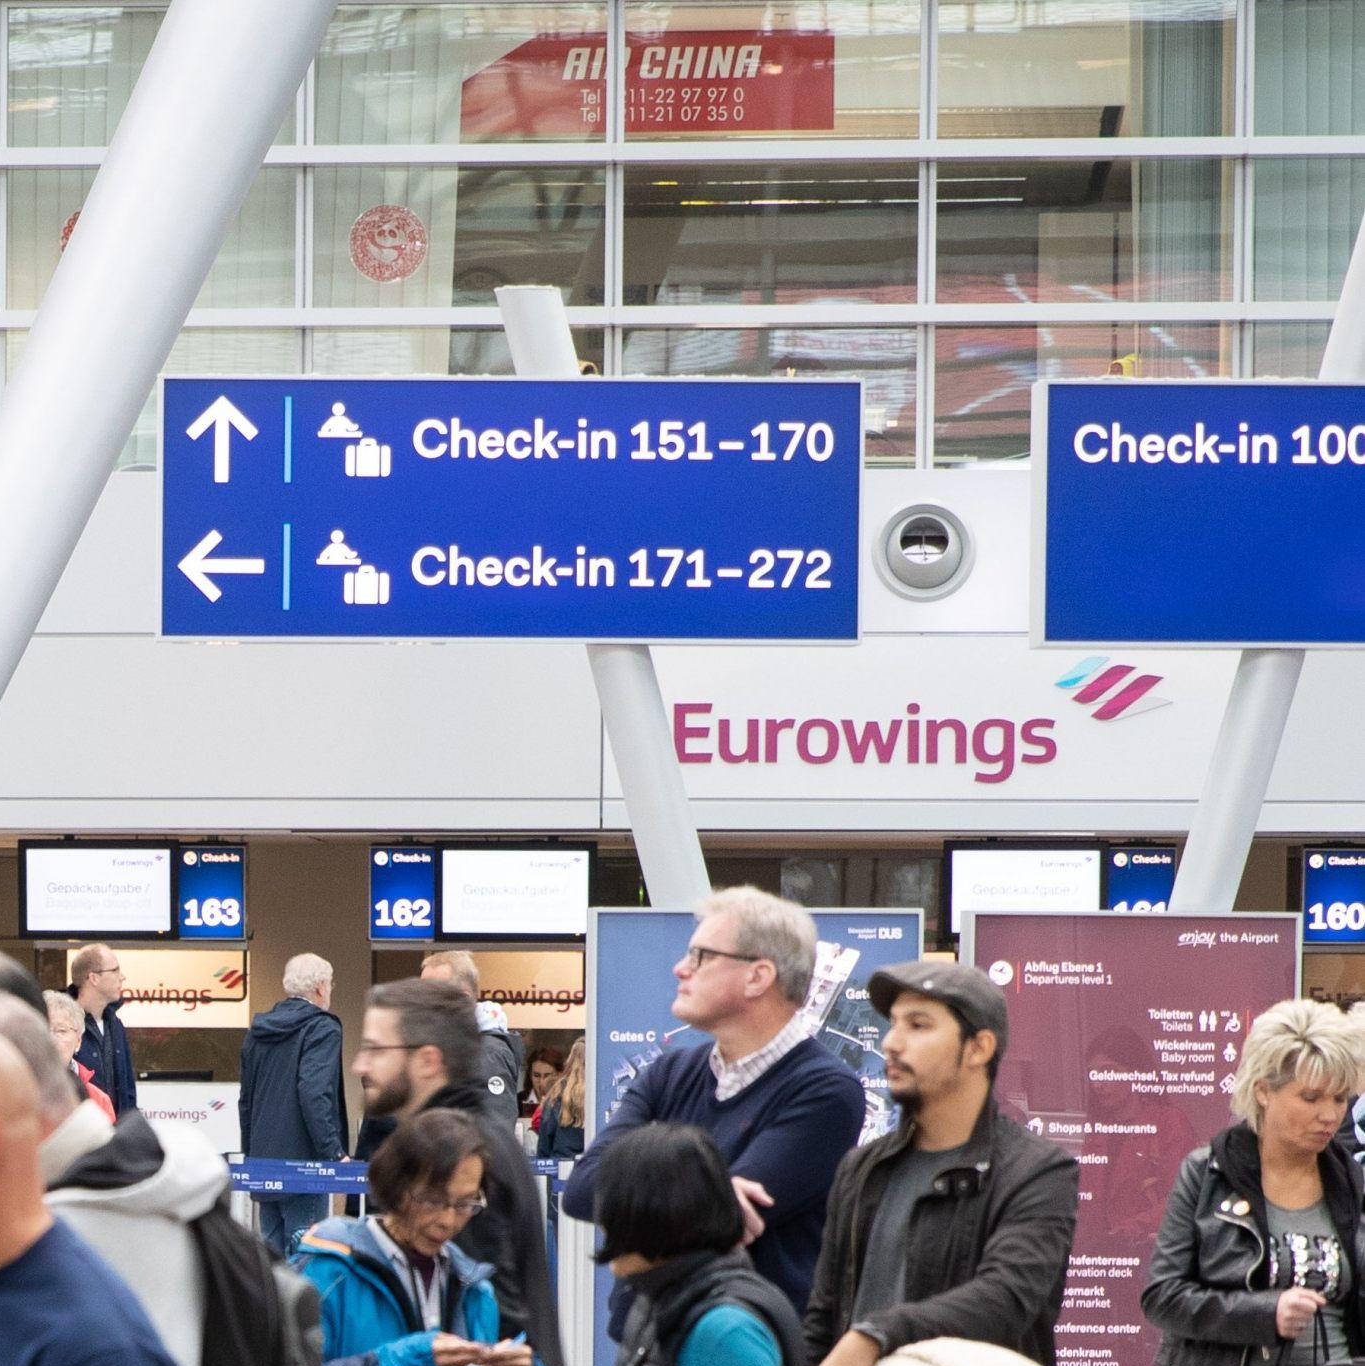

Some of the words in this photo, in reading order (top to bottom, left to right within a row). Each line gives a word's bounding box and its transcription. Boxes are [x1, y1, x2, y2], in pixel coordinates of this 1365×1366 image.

[639, 45, 762, 79] CHINA
[580, 89, 600, 103] Tel
[624, 88, 674, 103] 11-22
[681, 88, 701, 103] 97
[707, 88, 728, 103] 97
[733, 88, 744, 103] 0
[580, 107, 600, 122] Tel
[624, 107, 673, 122] 11-21
[681, 106, 701, 121] 07
[707, 106, 728, 121] 35
[733, 106, 744, 121] 0
[412, 418, 616, 459] Check-in
[1073, 423, 1278, 464] Check-in
[410, 546, 614, 587] Check-in
[673, 702, 1057, 784] Eurowings
[201, 852, 240, 863] Check-in
[1132, 854, 1171, 864] Check-in
[47, 882, 142, 896] Gepäckaufgabe
[184, 898, 240, 926] 163
[374, 898, 431, 927] 162
[1309, 902, 1365, 930] 160
[878, 927, 903, 940] DUS
[1177, 930, 1216, 949] enjoy
[1219, 932, 1238, 943] the
[1240, 932, 1279, 945] Airport
[1024, 961, 1059, 974] Abflug
[1061, 961, 1094, 973] Ebene
[1096, 962, 1103, 973] 1
[1024, 974, 1080, 986] Departures
[1082, 974, 1104, 984] level
[1106, 974, 1113, 985] 1
[120, 983, 212, 1011] owings
[481, 984, 585, 1012] rowings
[1147, 1009, 1193, 1020] Toiletten
[1160, 1021, 1193, 1032] Toilets
[610, 1030, 644, 1042] Gates
[646, 1030, 656, 1042] C
[1153, 1040, 1215, 1051] Wickelraum
[1161, 1052, 1187, 1065] Baby
[1188, 1054, 1215, 1062] room
[860, 1076, 890, 1088] Gate
[1089, 1070, 1159, 1083] Geldwechsel,
[1161, 1071, 1178, 1081] Tax
[1180, 1070, 1214, 1081] refund
[1131, 1083, 1165, 1095] Money
[1166, 1083, 1214, 1096] exchange
[1048, 1121, 1082, 1135] Shops
[1083, 1122, 1092, 1133] &
[1094, 1122, 1157, 1134] Restaurants
[265, 1181, 283, 1190] DUS
[1068, 1254, 1140, 1266] hafenterrasse
[1066, 1267, 1106, 1277] ervation
[1107, 1267, 1133, 1278] deck
[1076, 1298, 1111, 1308] market
[1053, 1322, 1106, 1333] onference
[1107, 1323, 1141, 1334] center
